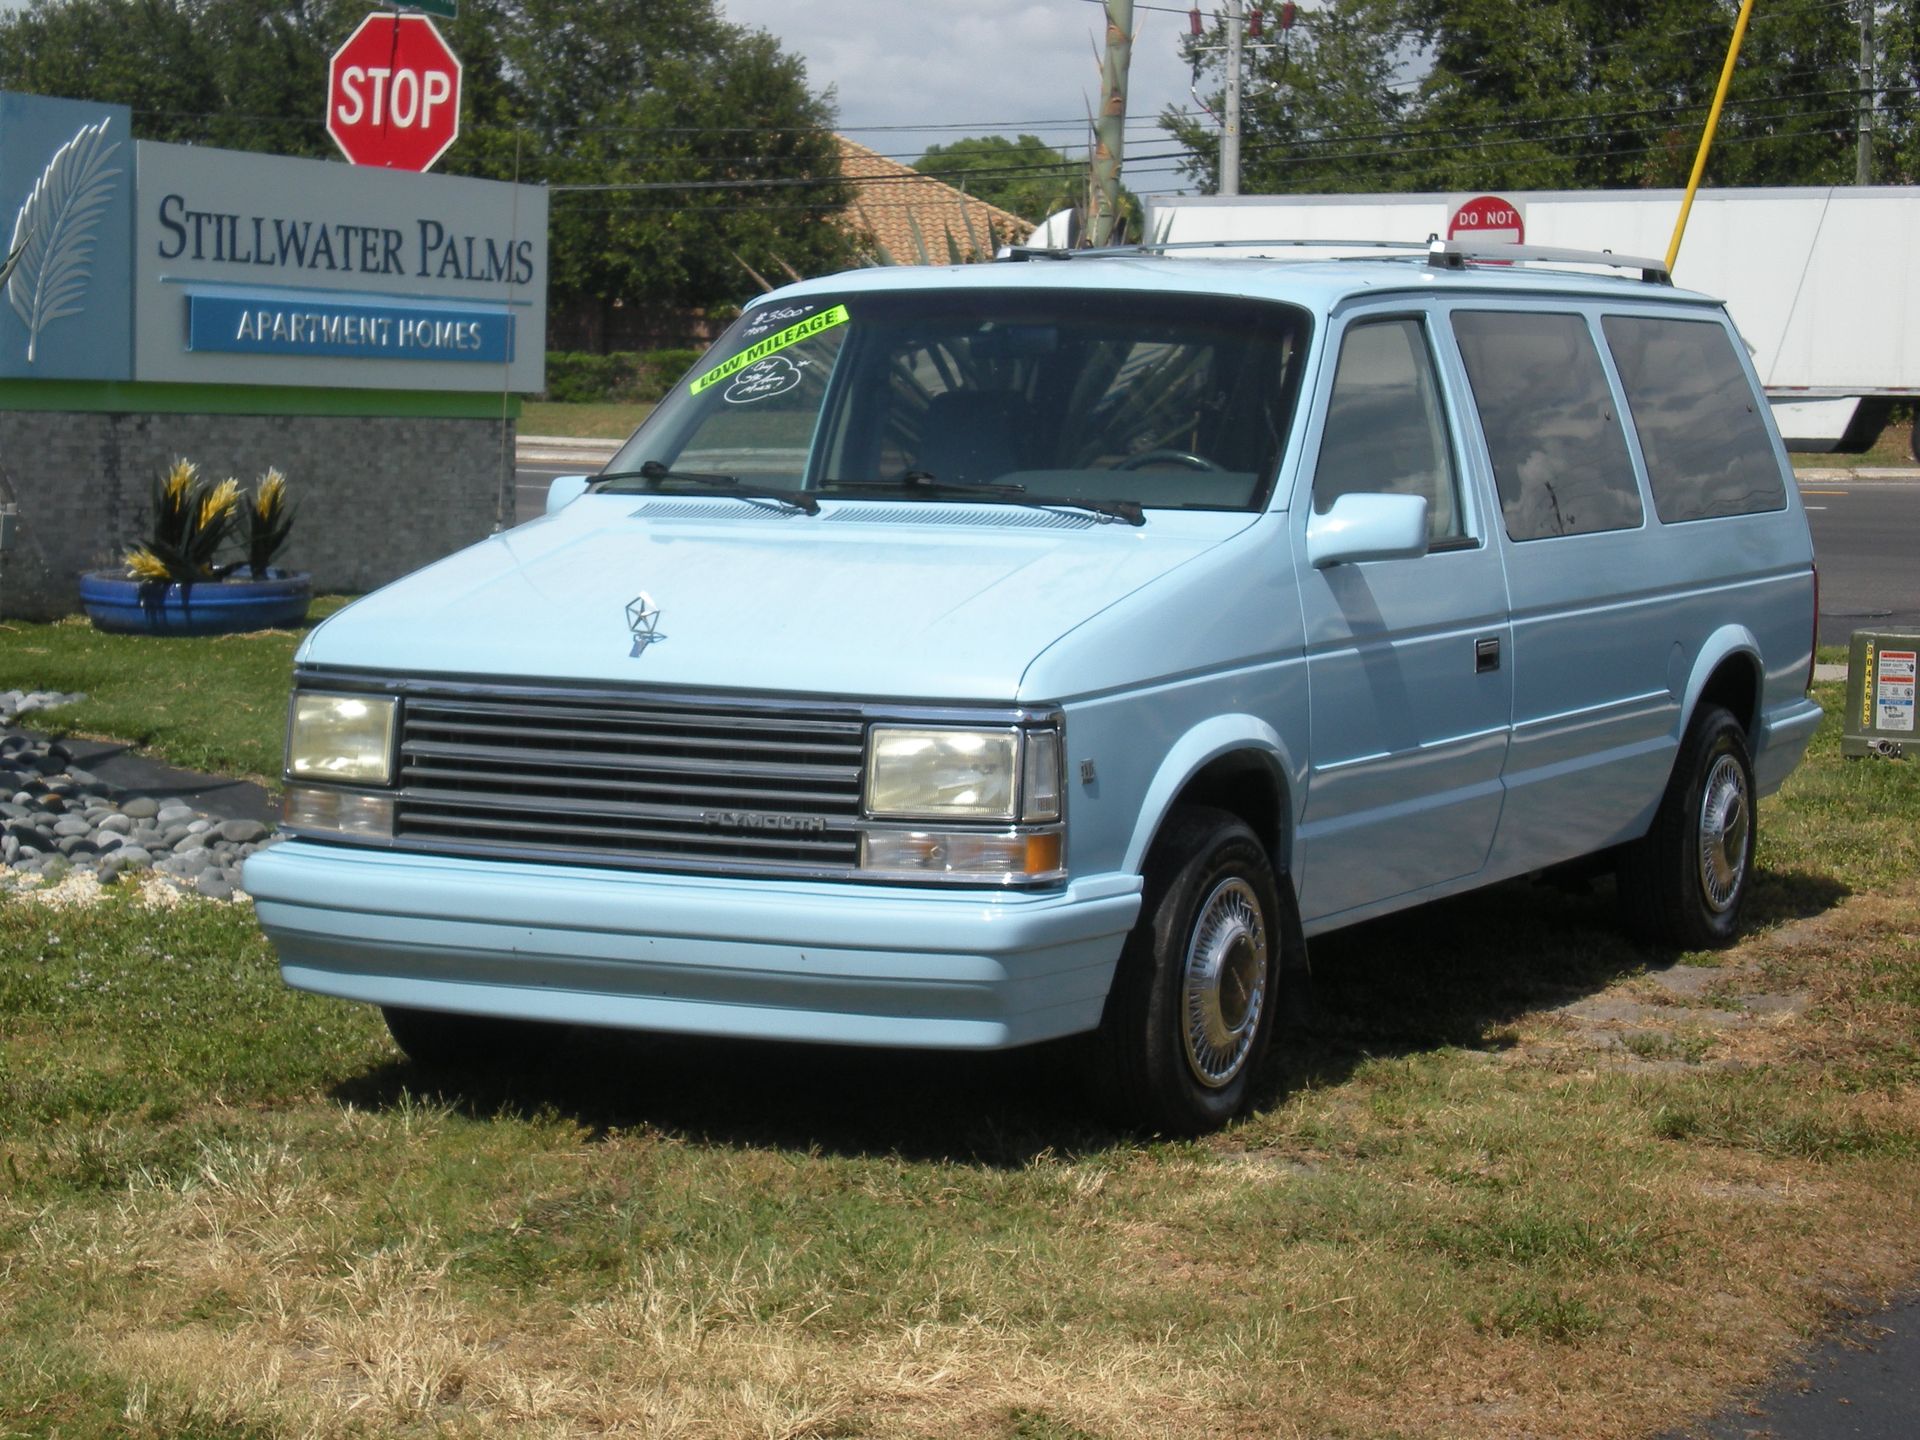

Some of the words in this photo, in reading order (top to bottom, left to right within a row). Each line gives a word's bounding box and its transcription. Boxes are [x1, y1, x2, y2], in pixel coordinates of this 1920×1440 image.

[338, 65, 451, 129] STOP
[158, 194, 406, 276] STILLWATER
[416, 219, 534, 285] PALMS
[1459, 212, 1478, 226] DO
[1486, 211, 1514, 225] NOT
[236, 311, 392, 347] APARTMENT
[399, 319, 481, 350] HOMES
[700, 356, 742, 389] LOW
[746, 309, 836, 362] MILEAGE
[703, 811, 827, 832] PLYMOUTH
